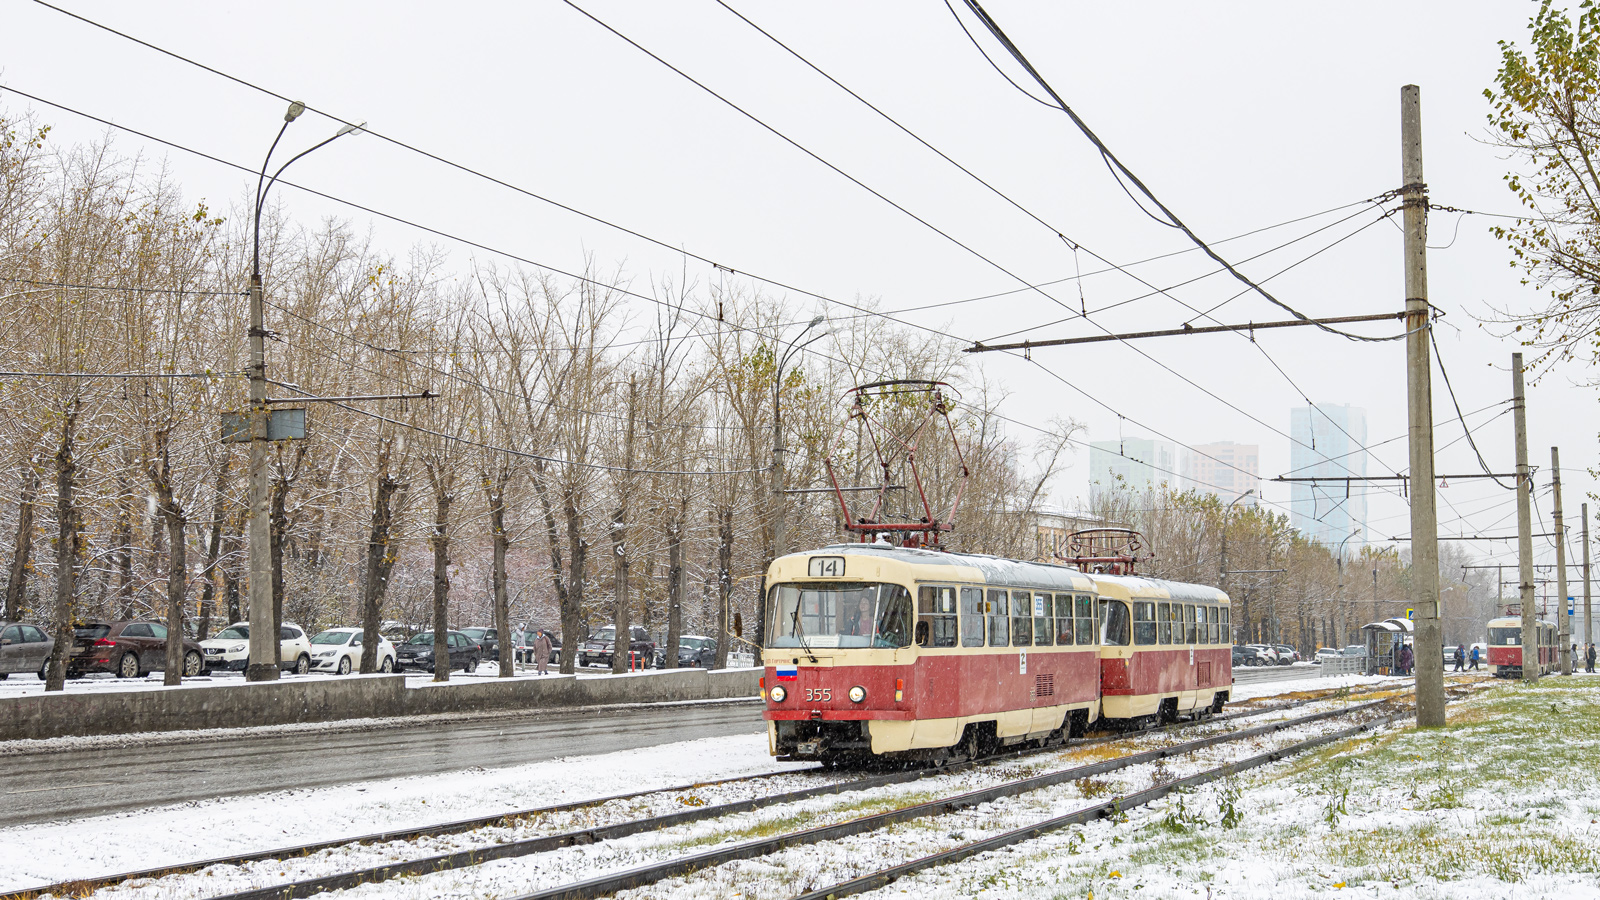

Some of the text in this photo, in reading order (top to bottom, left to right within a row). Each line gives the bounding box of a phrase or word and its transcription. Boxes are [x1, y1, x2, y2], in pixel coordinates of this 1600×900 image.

[818, 560, 837, 576] 14
[1020, 652, 1026, 665] 2
[805, 688, 832, 702] 355
